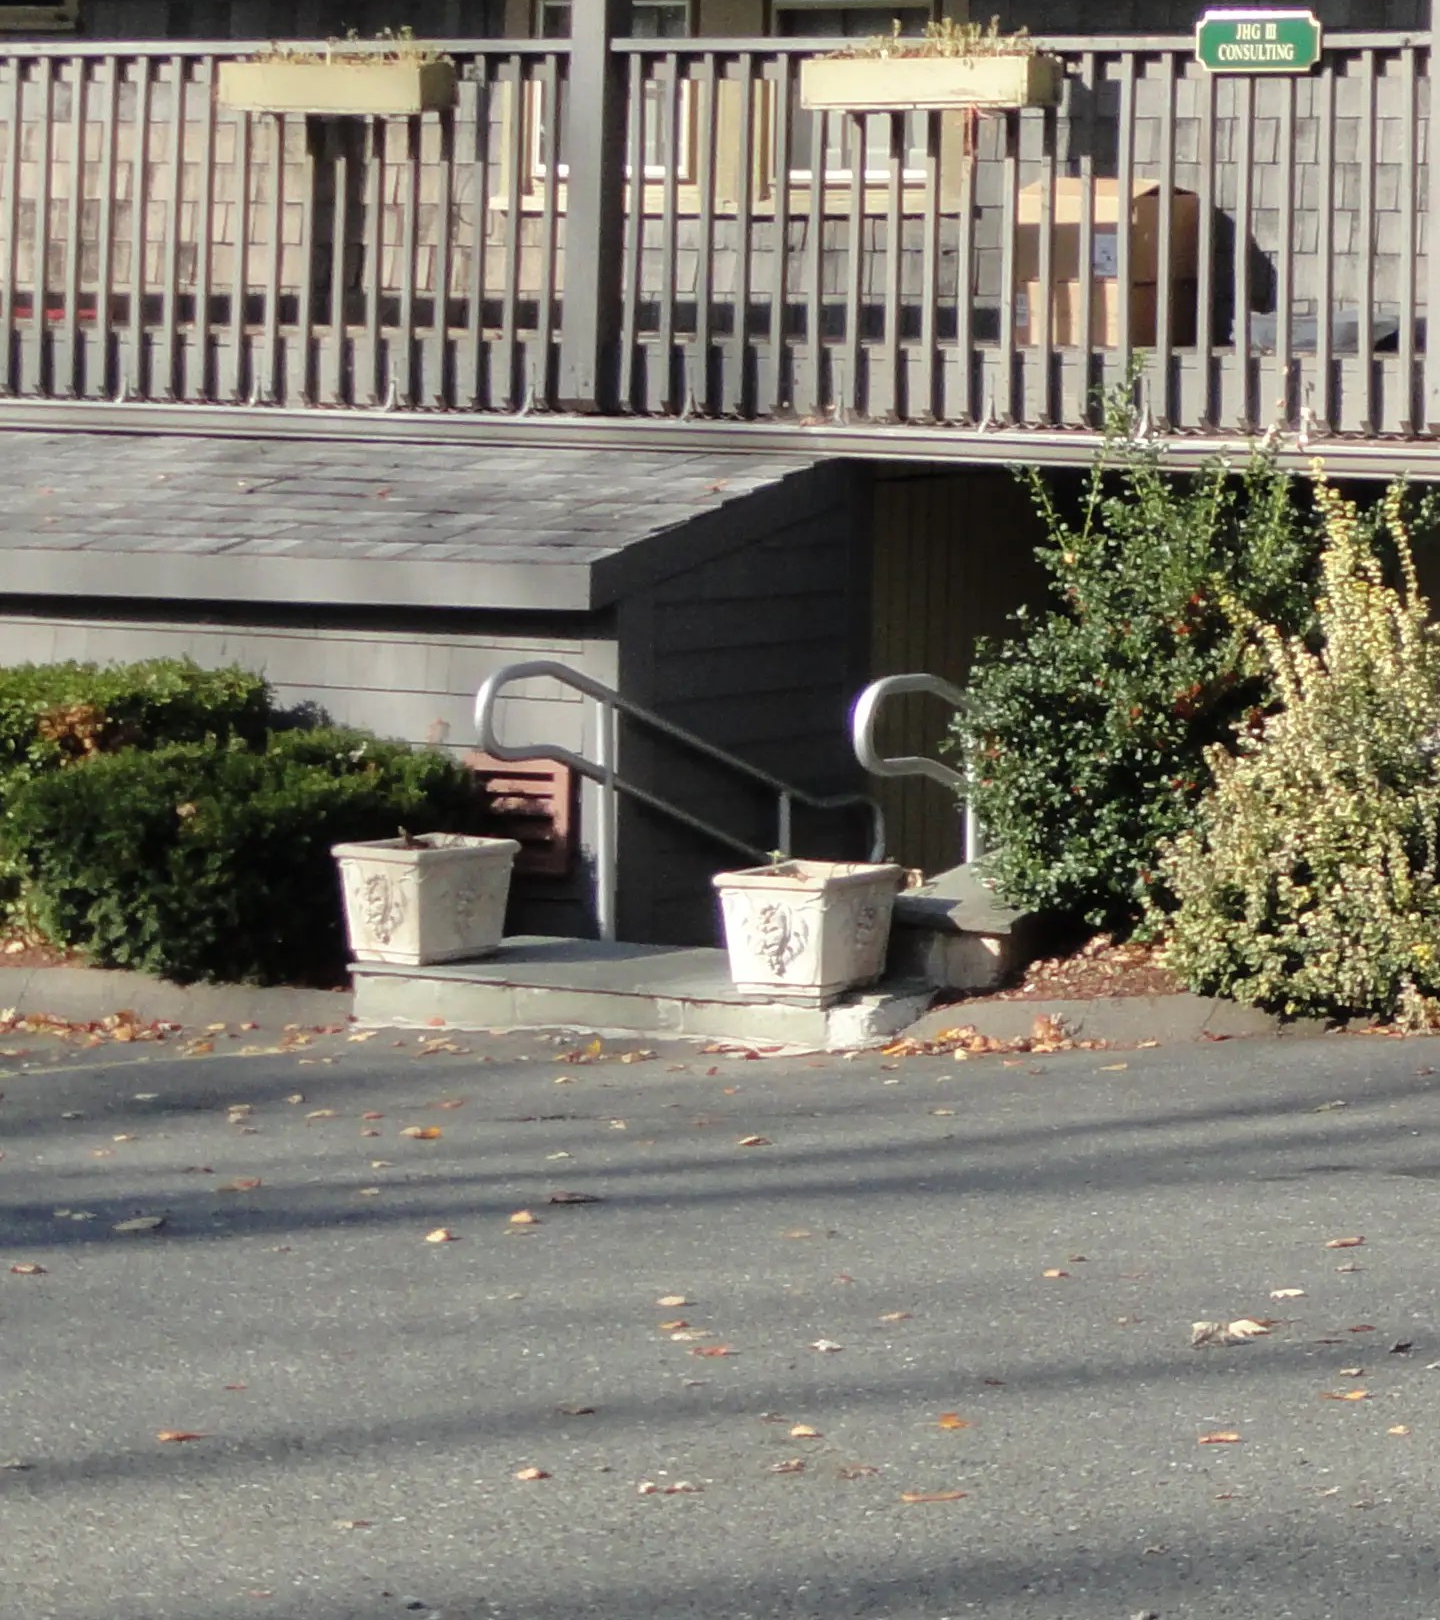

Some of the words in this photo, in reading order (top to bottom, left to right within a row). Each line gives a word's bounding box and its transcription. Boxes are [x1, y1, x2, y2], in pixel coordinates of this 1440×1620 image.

[1235, 23, 1261, 41] JHG
[1265, 23, 1278, 41] III
[1217, 43, 1295, 61] CONSULTING
